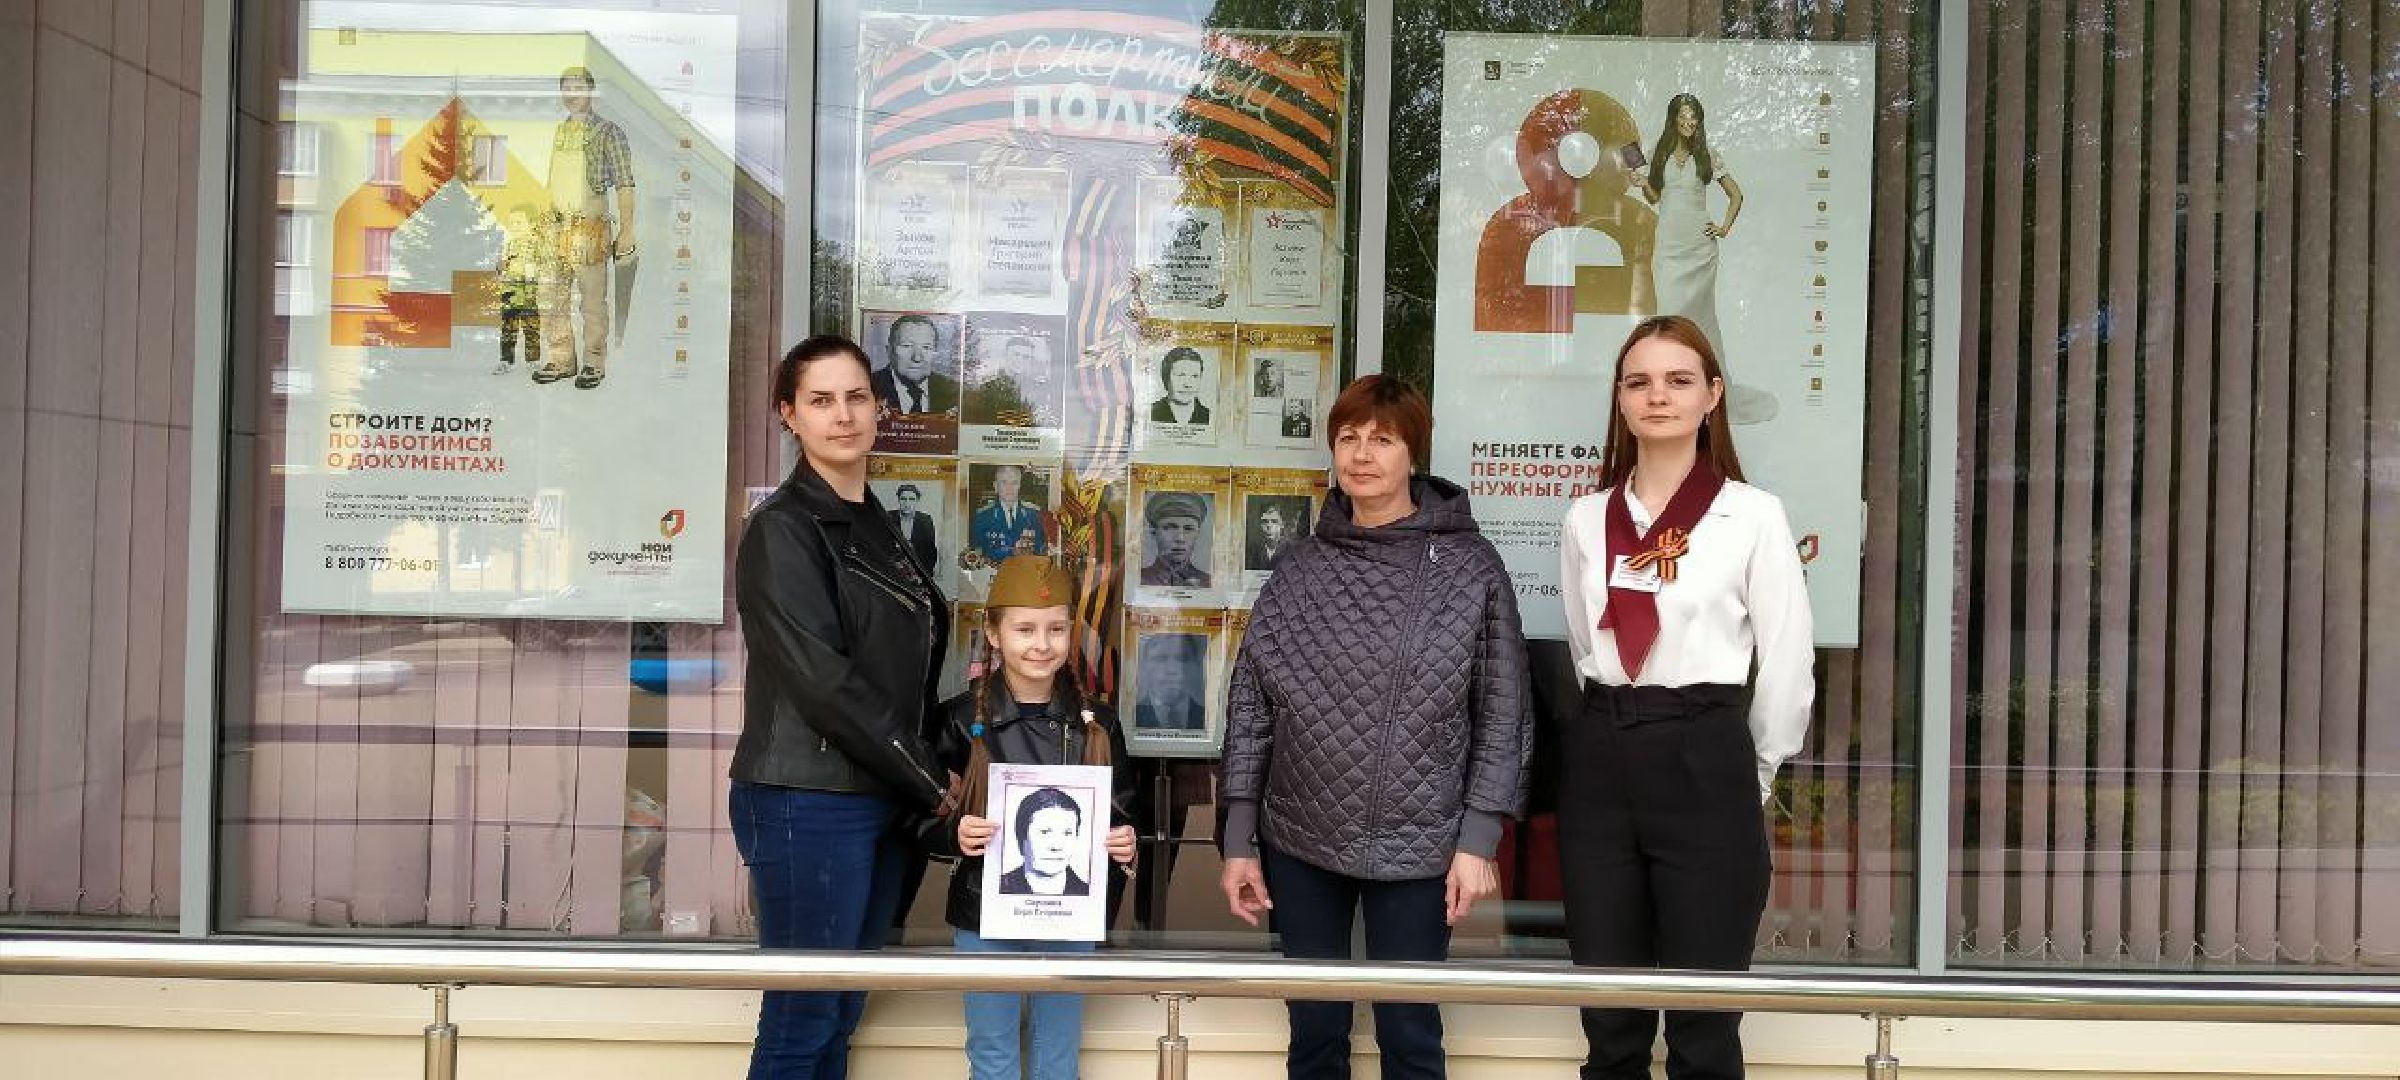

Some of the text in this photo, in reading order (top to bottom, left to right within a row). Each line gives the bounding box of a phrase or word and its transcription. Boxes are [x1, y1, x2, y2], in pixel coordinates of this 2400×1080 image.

[329, 413, 492, 433] СТРОИТЕ ДОМ?
[329, 432, 491, 452] ПОЗАБОТИМСЯ
[1472, 441, 1565, 459] МЕНЯЕТЕ
[328, 452, 504, 473] О ДОКУМЕНТАХ!
[1470, 480, 1562, 497] НУЖНЫЕ
[325, 556, 334, 569] 8
[338, 557, 365, 570] 800
